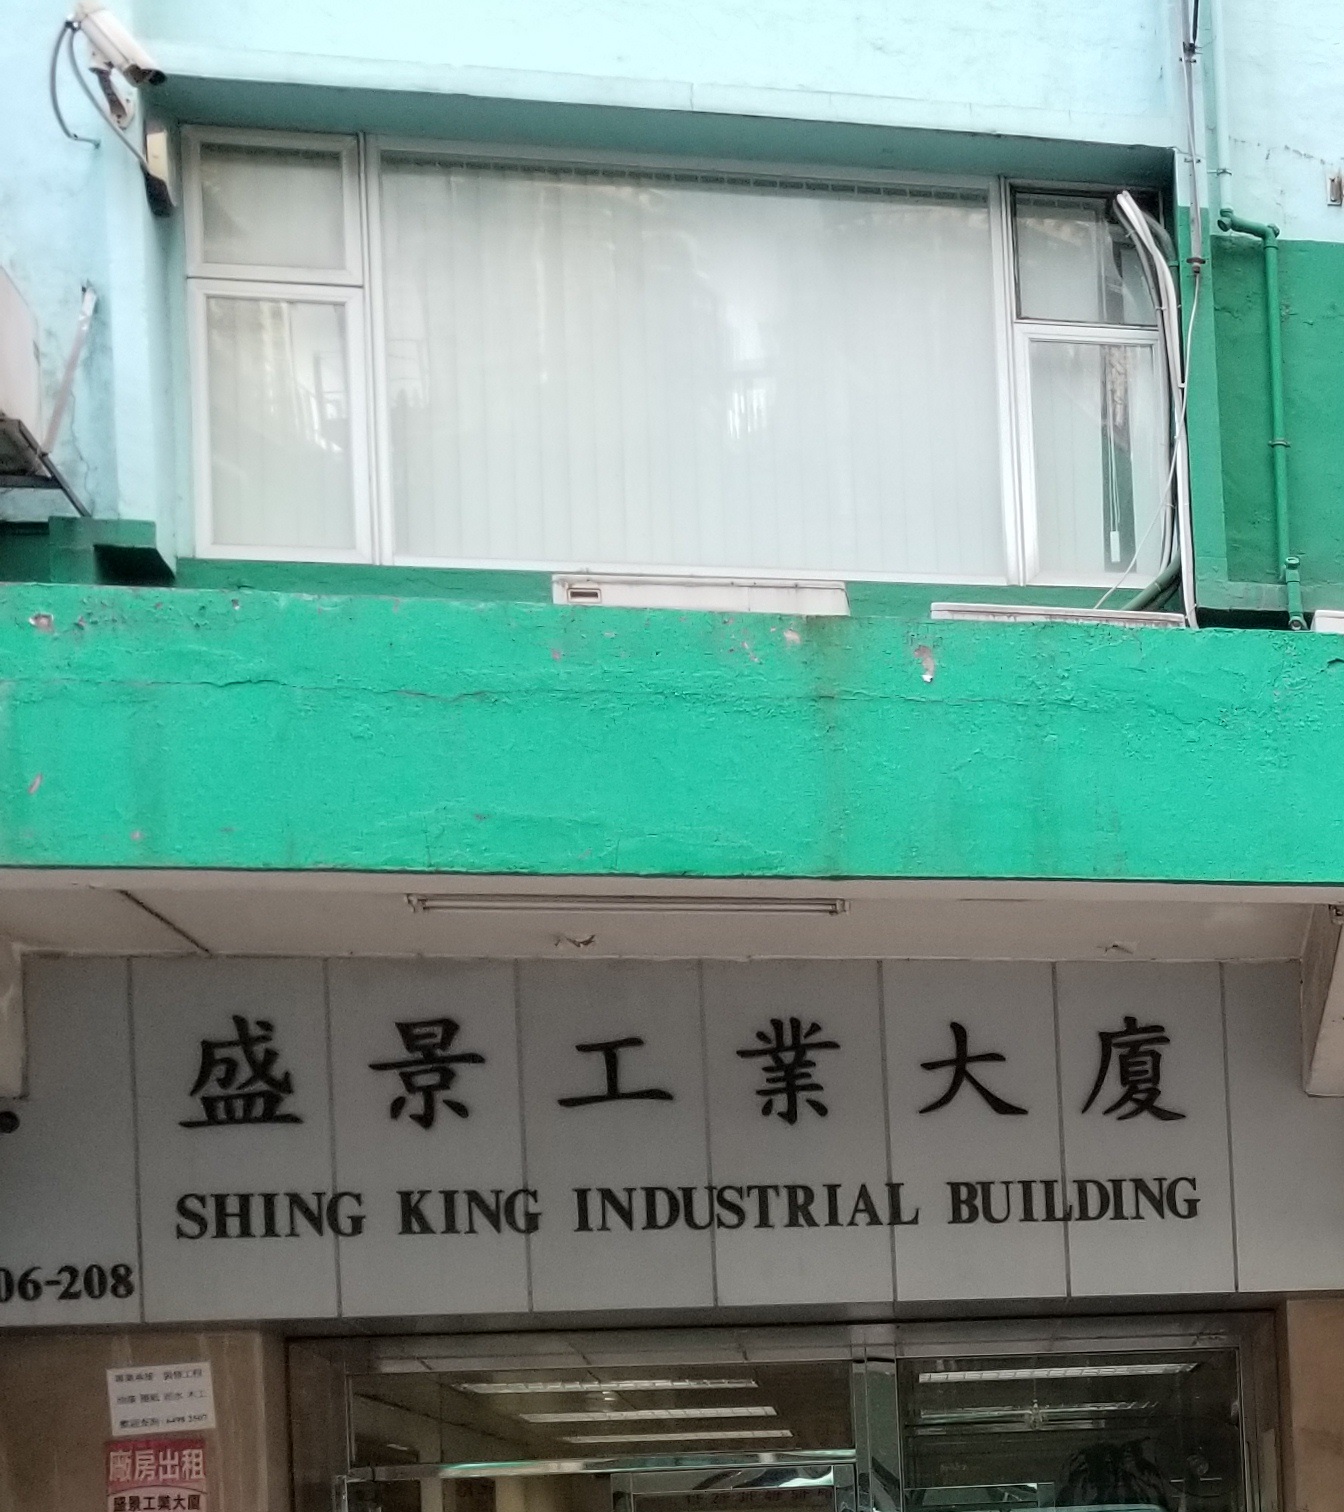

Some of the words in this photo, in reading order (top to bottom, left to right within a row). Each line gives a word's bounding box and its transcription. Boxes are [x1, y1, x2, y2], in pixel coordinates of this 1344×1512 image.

[178, 1014, 1187, 1129] 盛景工業大廈
[175, 1192, 365, 1241] SHING
[397, 1188, 543, 1236] KING
[572, 1181, 920, 1233] INDUSTRIAL
[946, 1176, 1201, 1225] BUILDING
